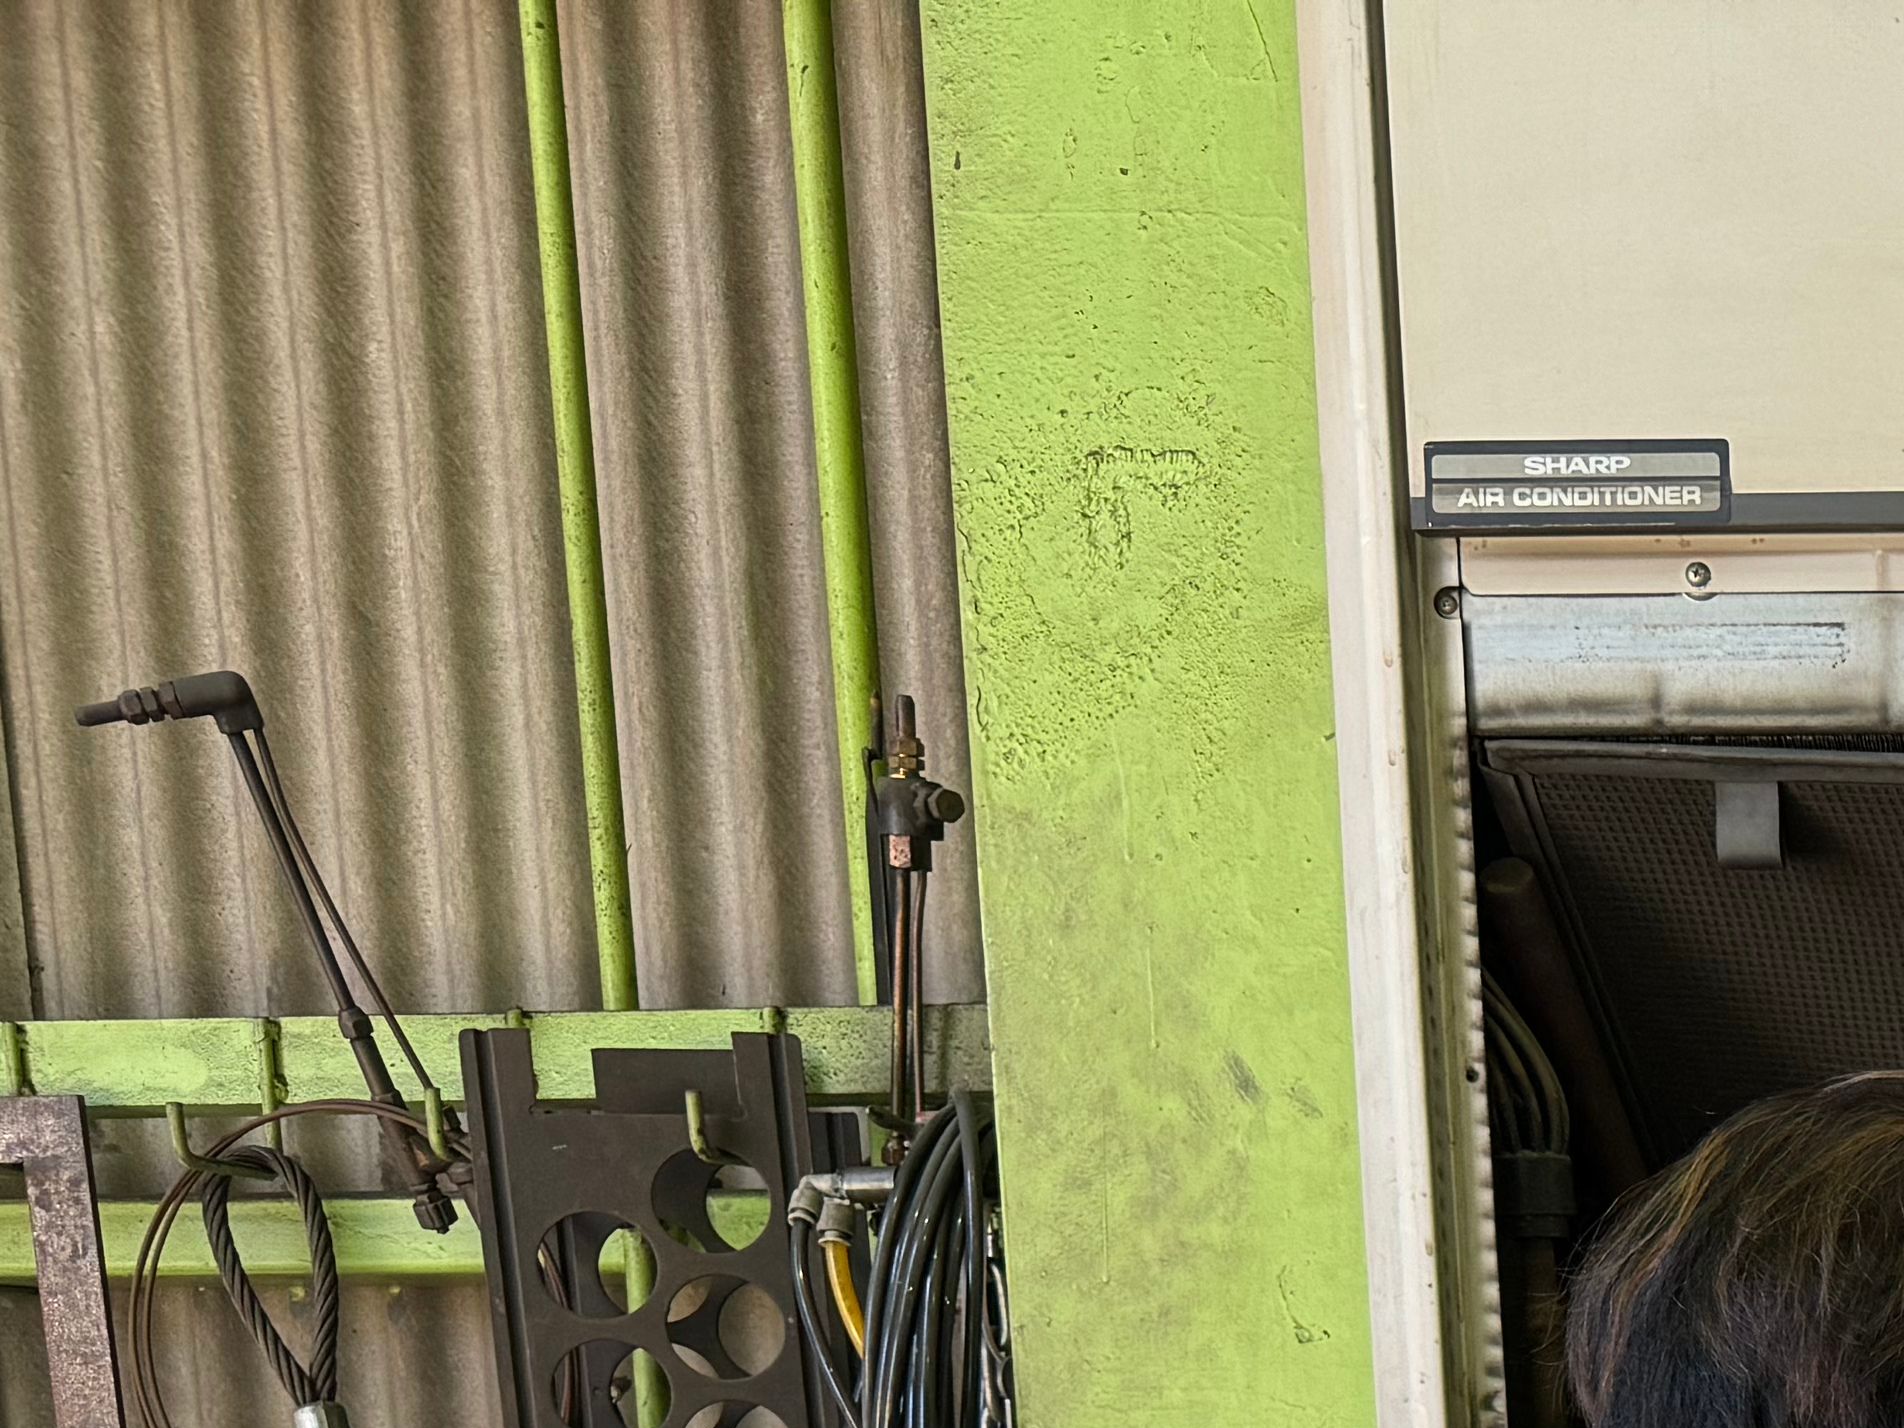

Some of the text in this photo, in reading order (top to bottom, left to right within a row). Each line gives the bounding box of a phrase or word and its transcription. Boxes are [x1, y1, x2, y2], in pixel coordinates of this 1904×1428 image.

[1524, 456, 1632, 475] SHARP
[1456, 485, 1702, 508] AIR CONDITIONER
